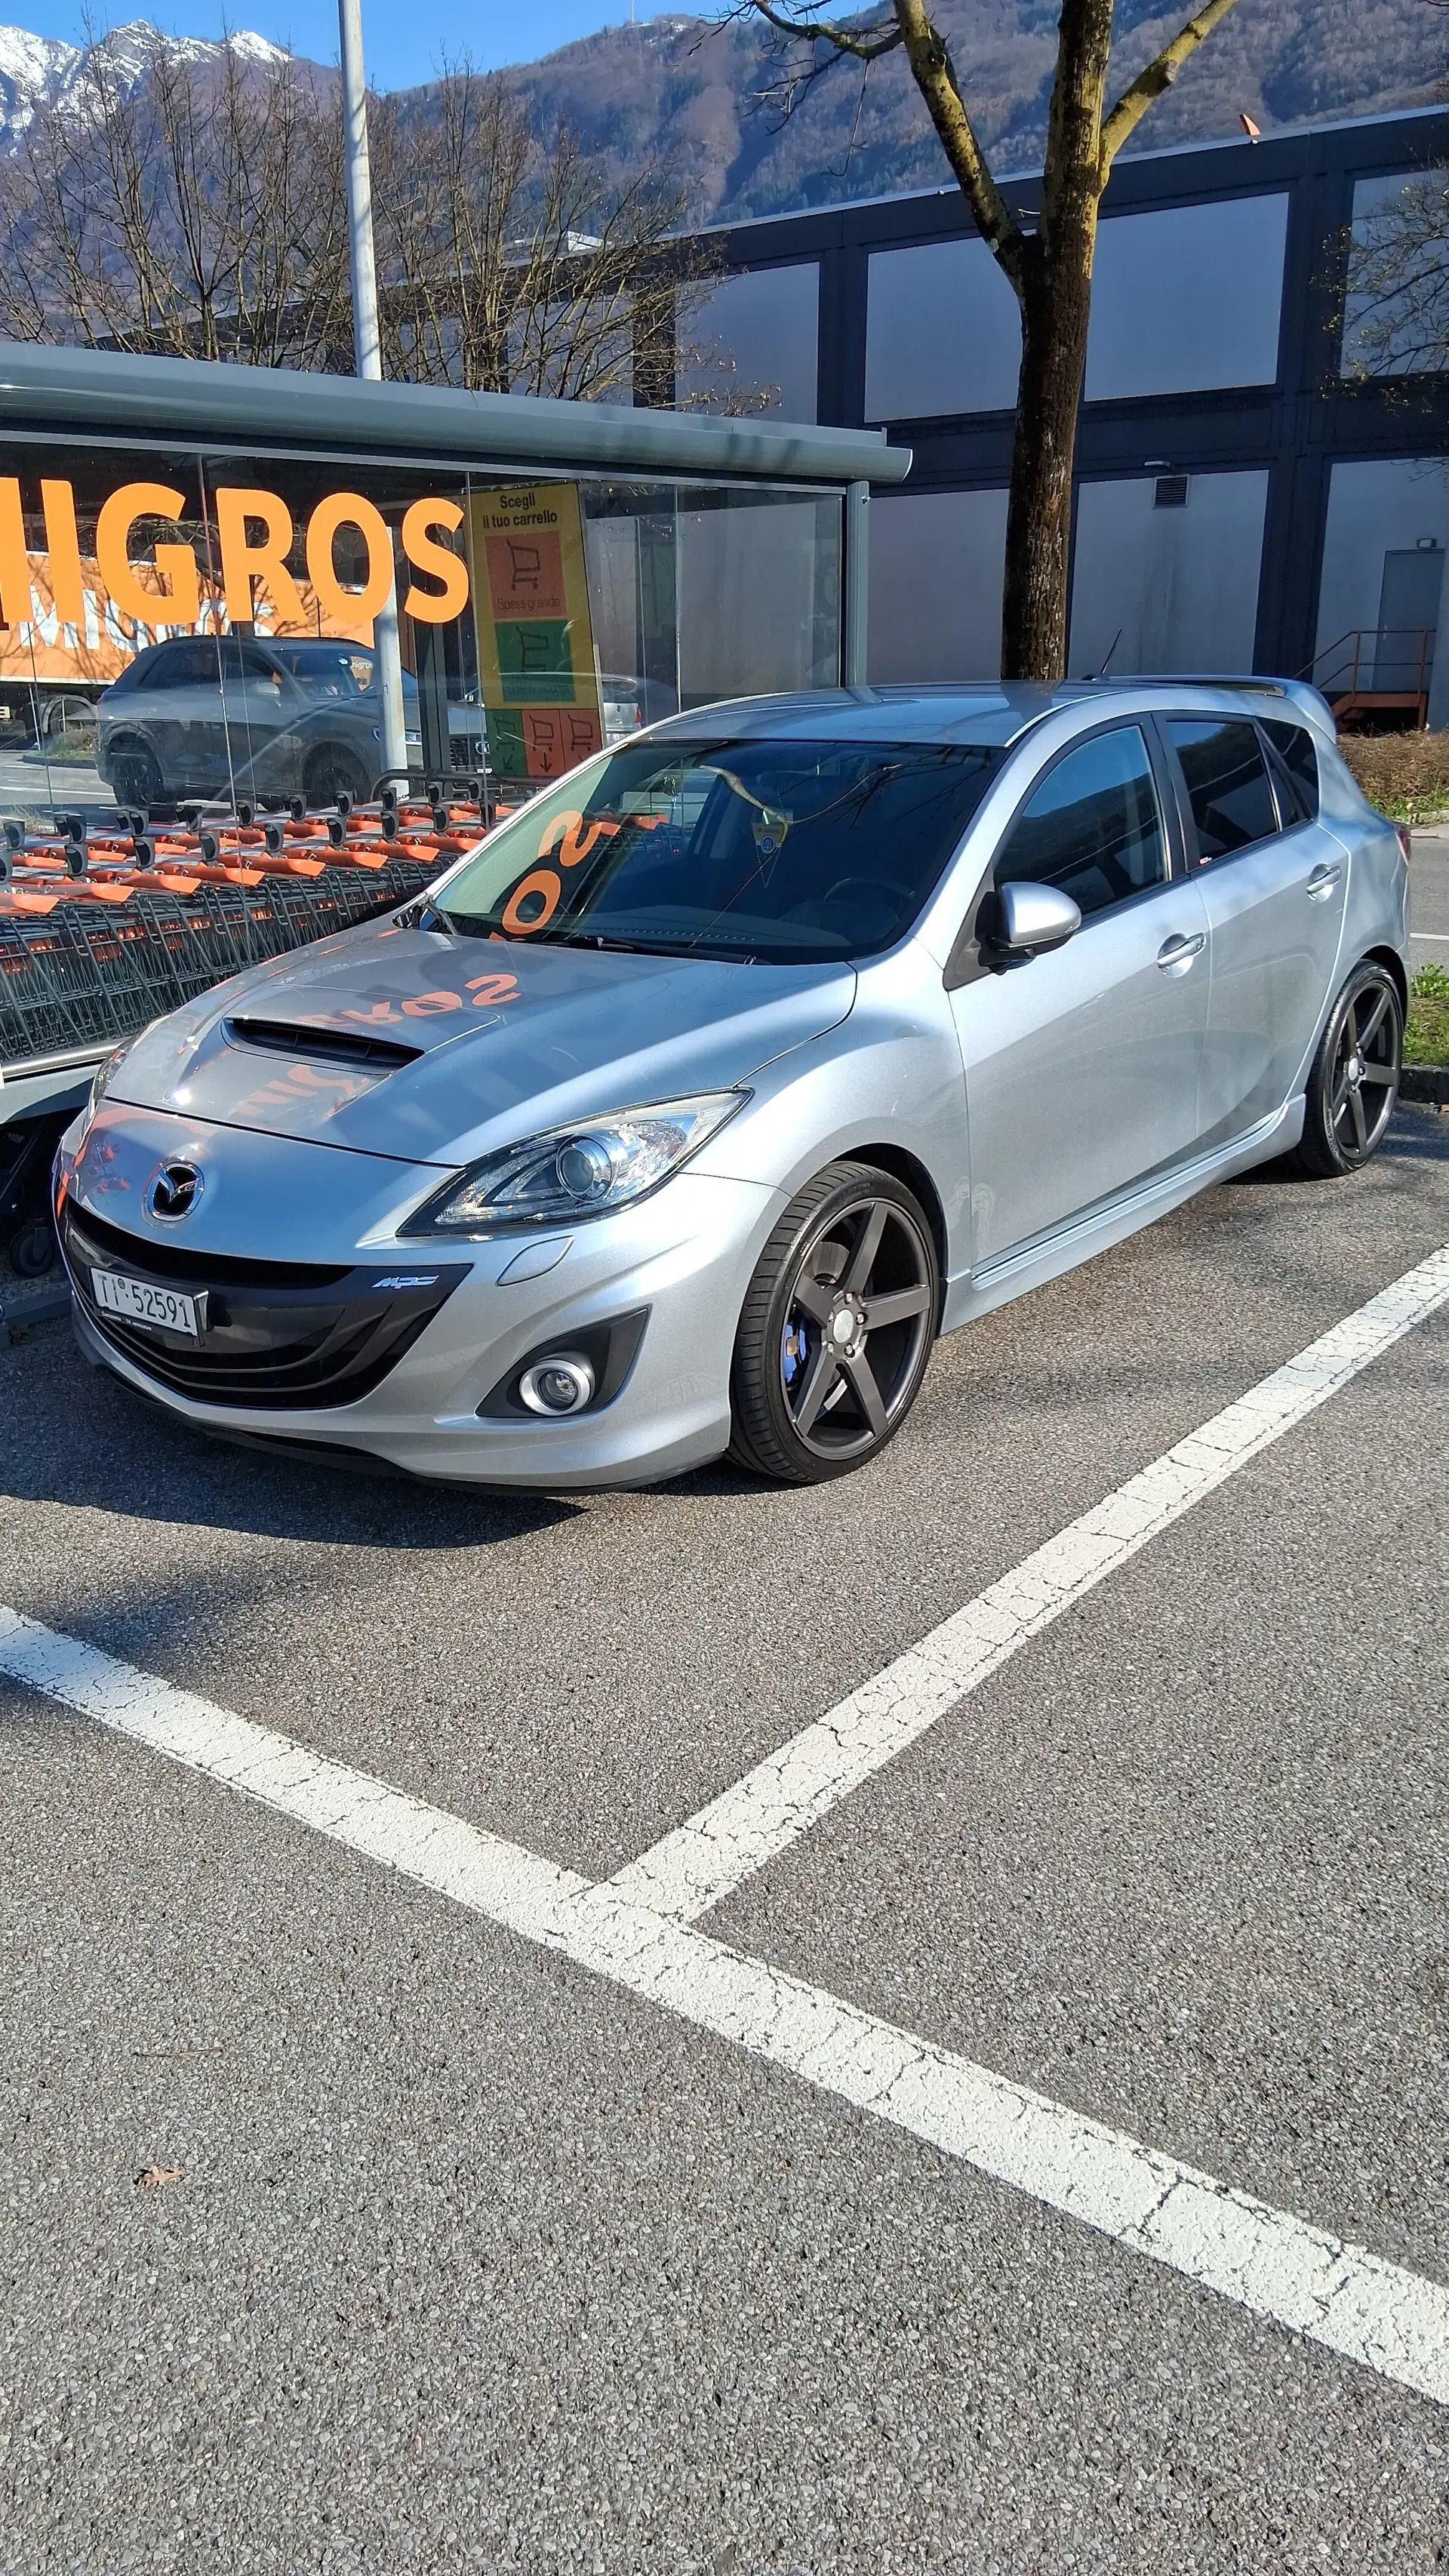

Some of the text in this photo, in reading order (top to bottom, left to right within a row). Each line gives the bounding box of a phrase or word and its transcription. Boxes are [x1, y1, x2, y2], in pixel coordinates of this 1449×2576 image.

[500, 492, 535, 510] Scegli
[492, 516, 510, 528] tuo
[513, 509, 558, 526] carrello
